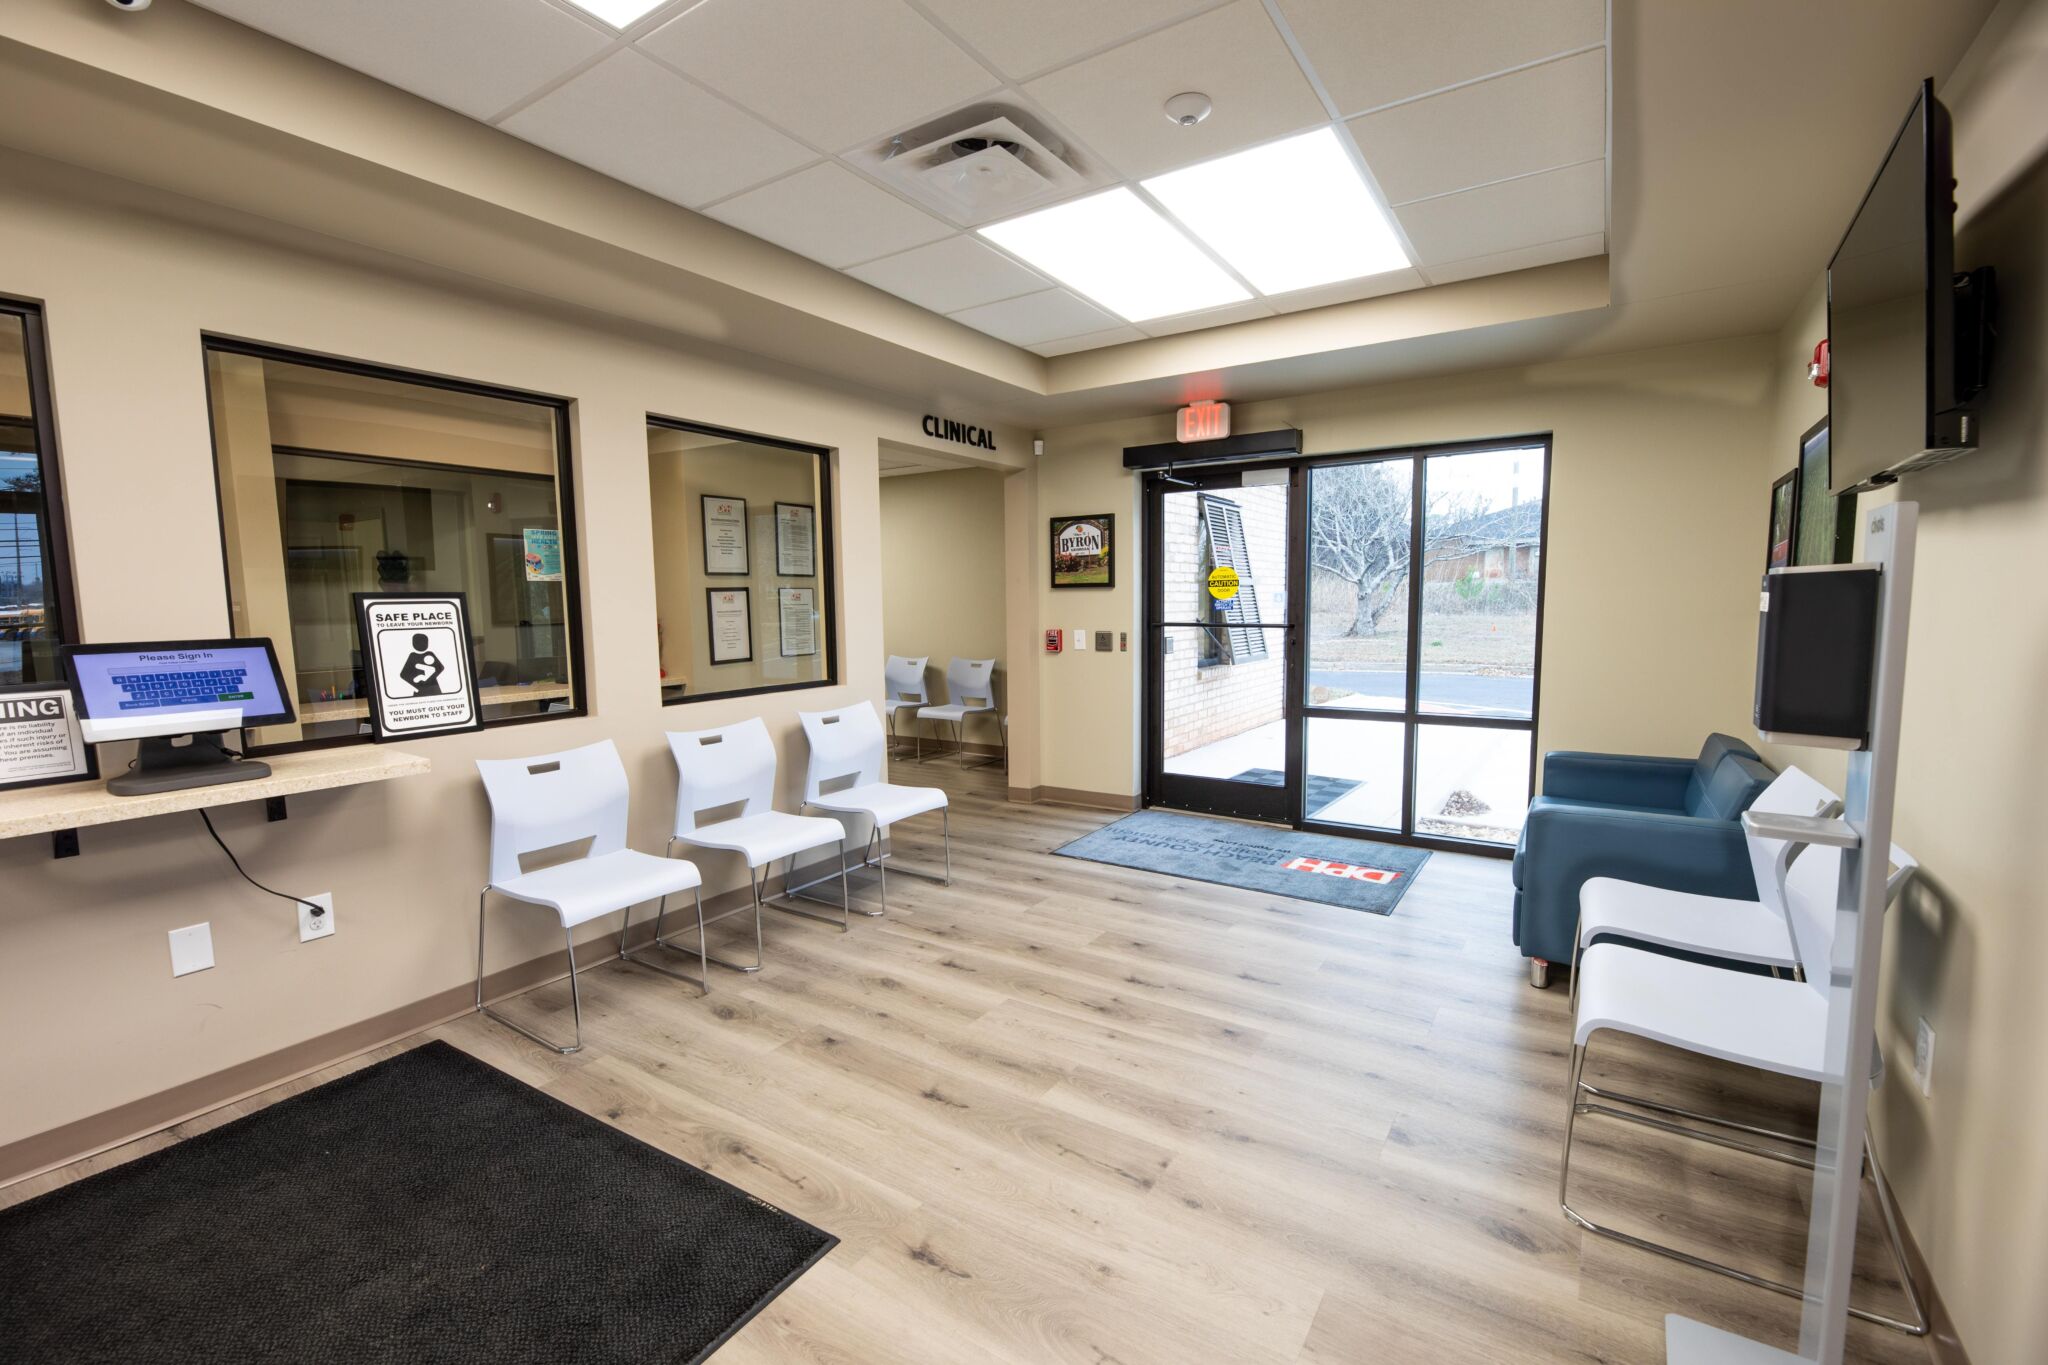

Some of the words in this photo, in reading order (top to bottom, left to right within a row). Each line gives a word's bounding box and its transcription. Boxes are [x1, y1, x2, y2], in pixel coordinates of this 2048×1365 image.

[1184, 406, 1221, 437] EXIT
[922, 414, 997, 451] CLINICAL
[1061, 534, 1099, 552] BYRON
[375, 613, 409, 622] SAFE
[412, 612, 452, 621] PLACE
[139, 654, 176, 662] Please
[178, 653, 202, 661] Sign
[393, 714, 430, 722] NEWBORN
[18, 728, 54, 736] individual
[36, 734, 57, 742] injury
[19, 753, 56, 761] premises.
[33, 745, 68, 753] assuming
[1105, 827, 1214, 849] Department
[1112, 835, 1200, 853] COUNTY
[1203, 850, 1278, 866] PEACH
[1219, 843, 1284, 860] Health
[1284, 857, 1397, 885] DPH
